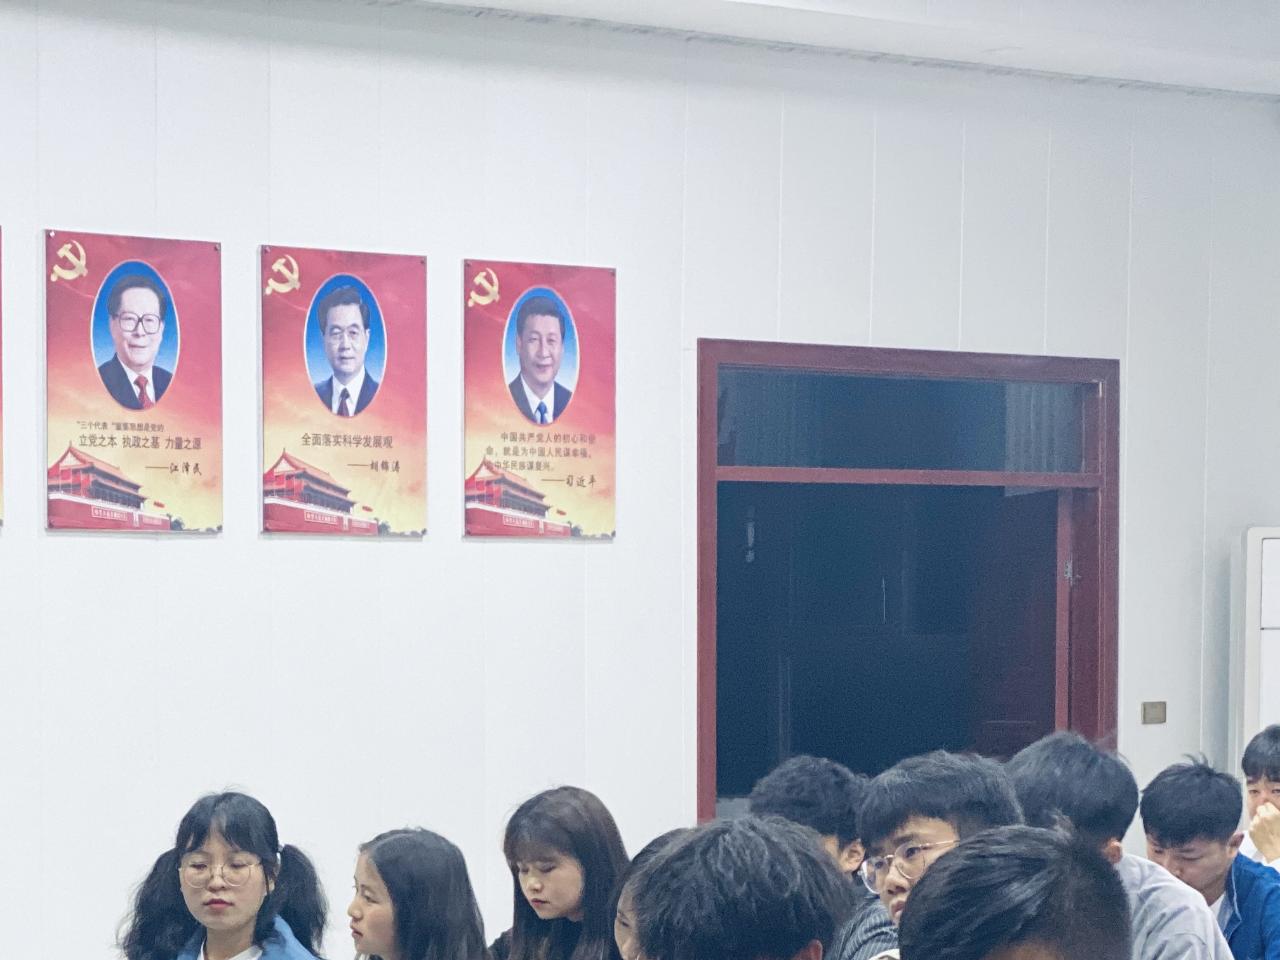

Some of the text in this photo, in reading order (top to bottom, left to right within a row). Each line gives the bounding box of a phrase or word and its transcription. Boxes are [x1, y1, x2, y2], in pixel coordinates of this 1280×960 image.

[302, 432, 393, 449] 全面落实科学发展观
